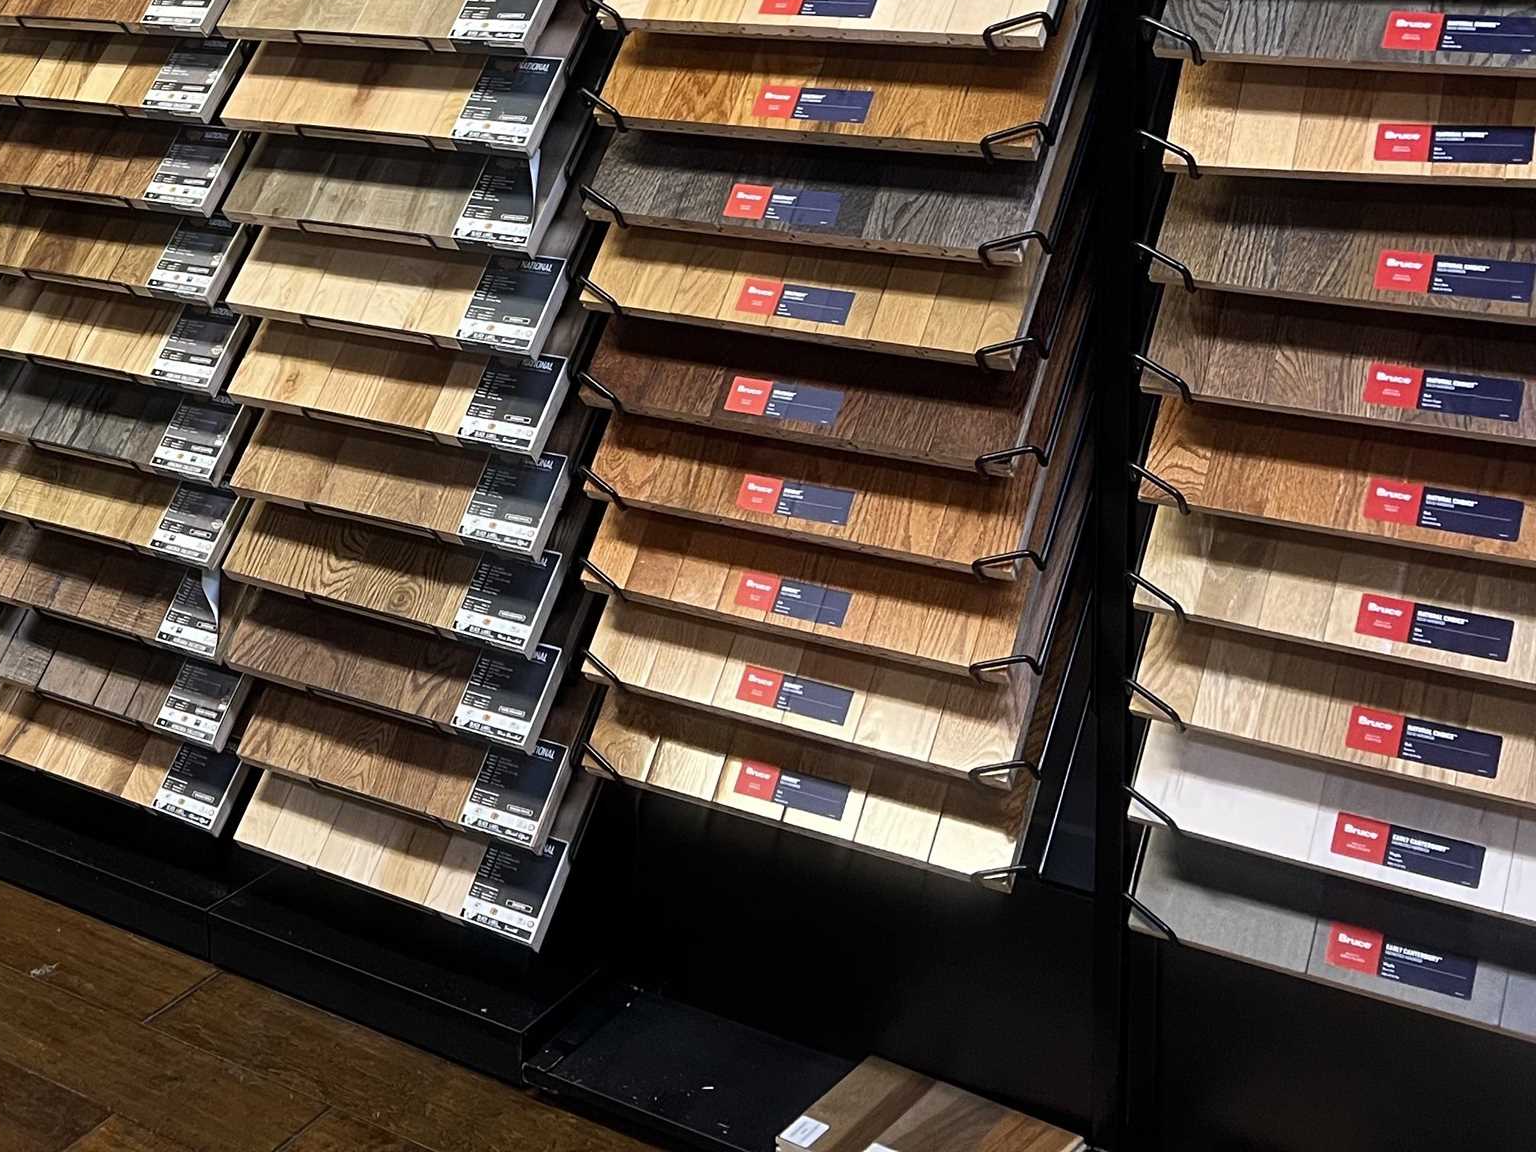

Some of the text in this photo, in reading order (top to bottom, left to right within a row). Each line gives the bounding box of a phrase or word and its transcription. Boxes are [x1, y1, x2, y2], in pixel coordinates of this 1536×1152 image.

[1396, 19, 1432, 28] Bruce
[1385, 131, 1420, 140] Bruce
[1387, 258, 1422, 269] Bruce
[1377, 372, 1411, 384] Bruce
[1377, 488, 1411, 500] Bruce
[1367, 602, 1403, 617] Bruce
[1359, 716, 1392, 730] Bruce
[1345, 824, 1378, 839] Bruce
[1338, 933, 1372, 951] Bruce
